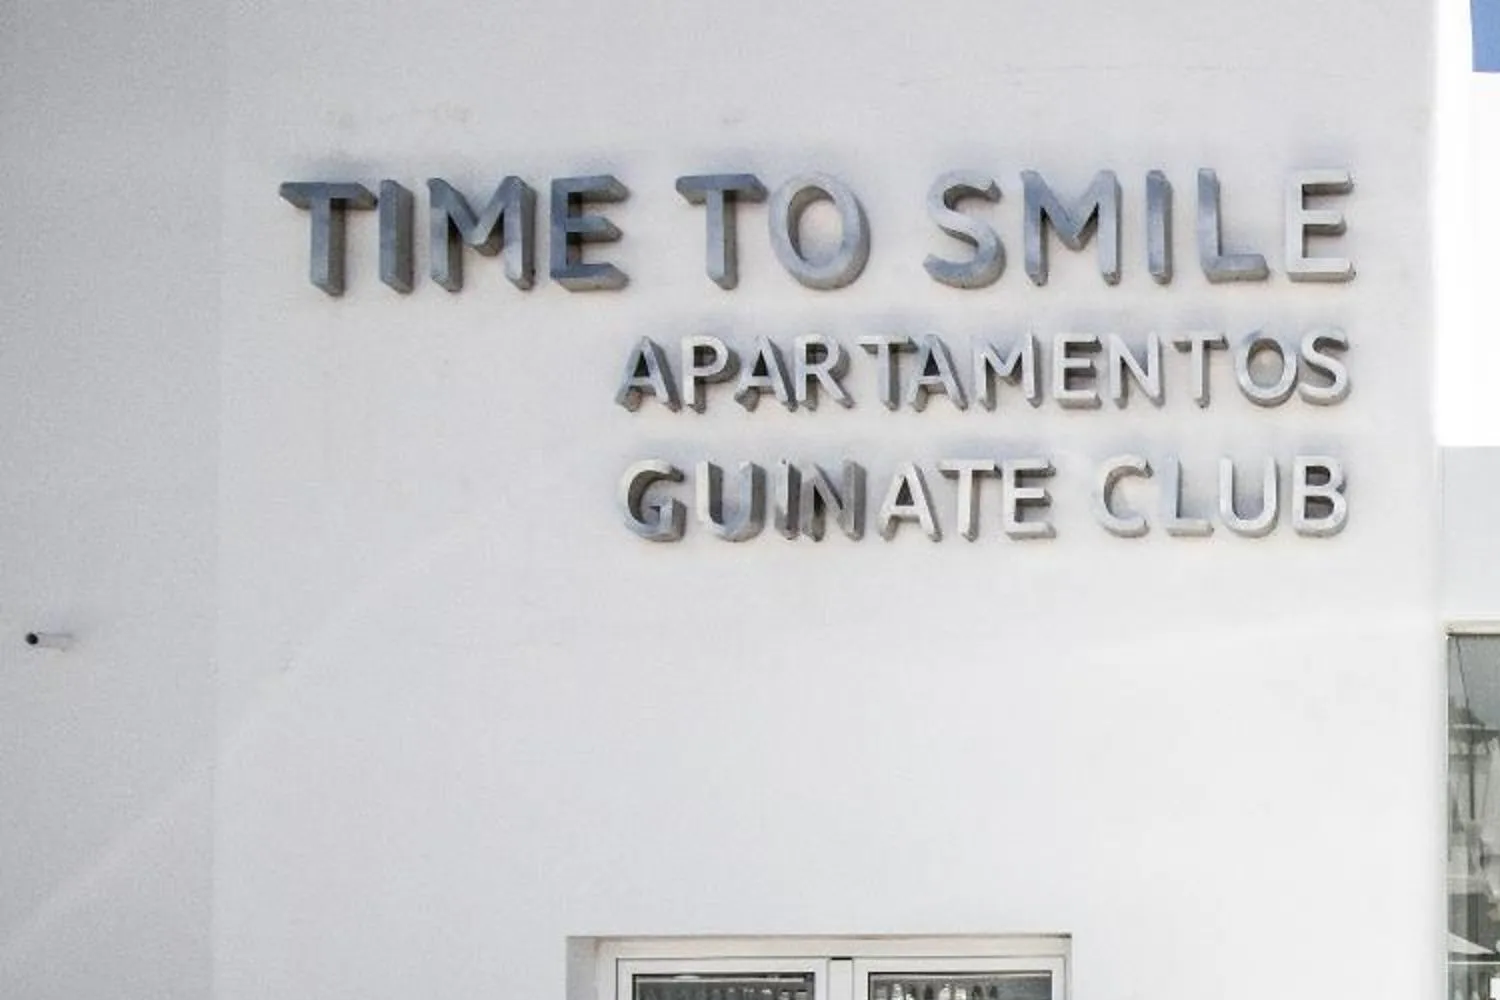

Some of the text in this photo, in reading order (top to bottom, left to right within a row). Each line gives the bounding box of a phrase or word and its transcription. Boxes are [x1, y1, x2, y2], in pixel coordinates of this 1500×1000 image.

[280, 167, 1358, 297] TIME TO SMILE
[614, 327, 1350, 412] APARTAMENTOS
[618, 453, 1349, 543] GUINATE CLUB
